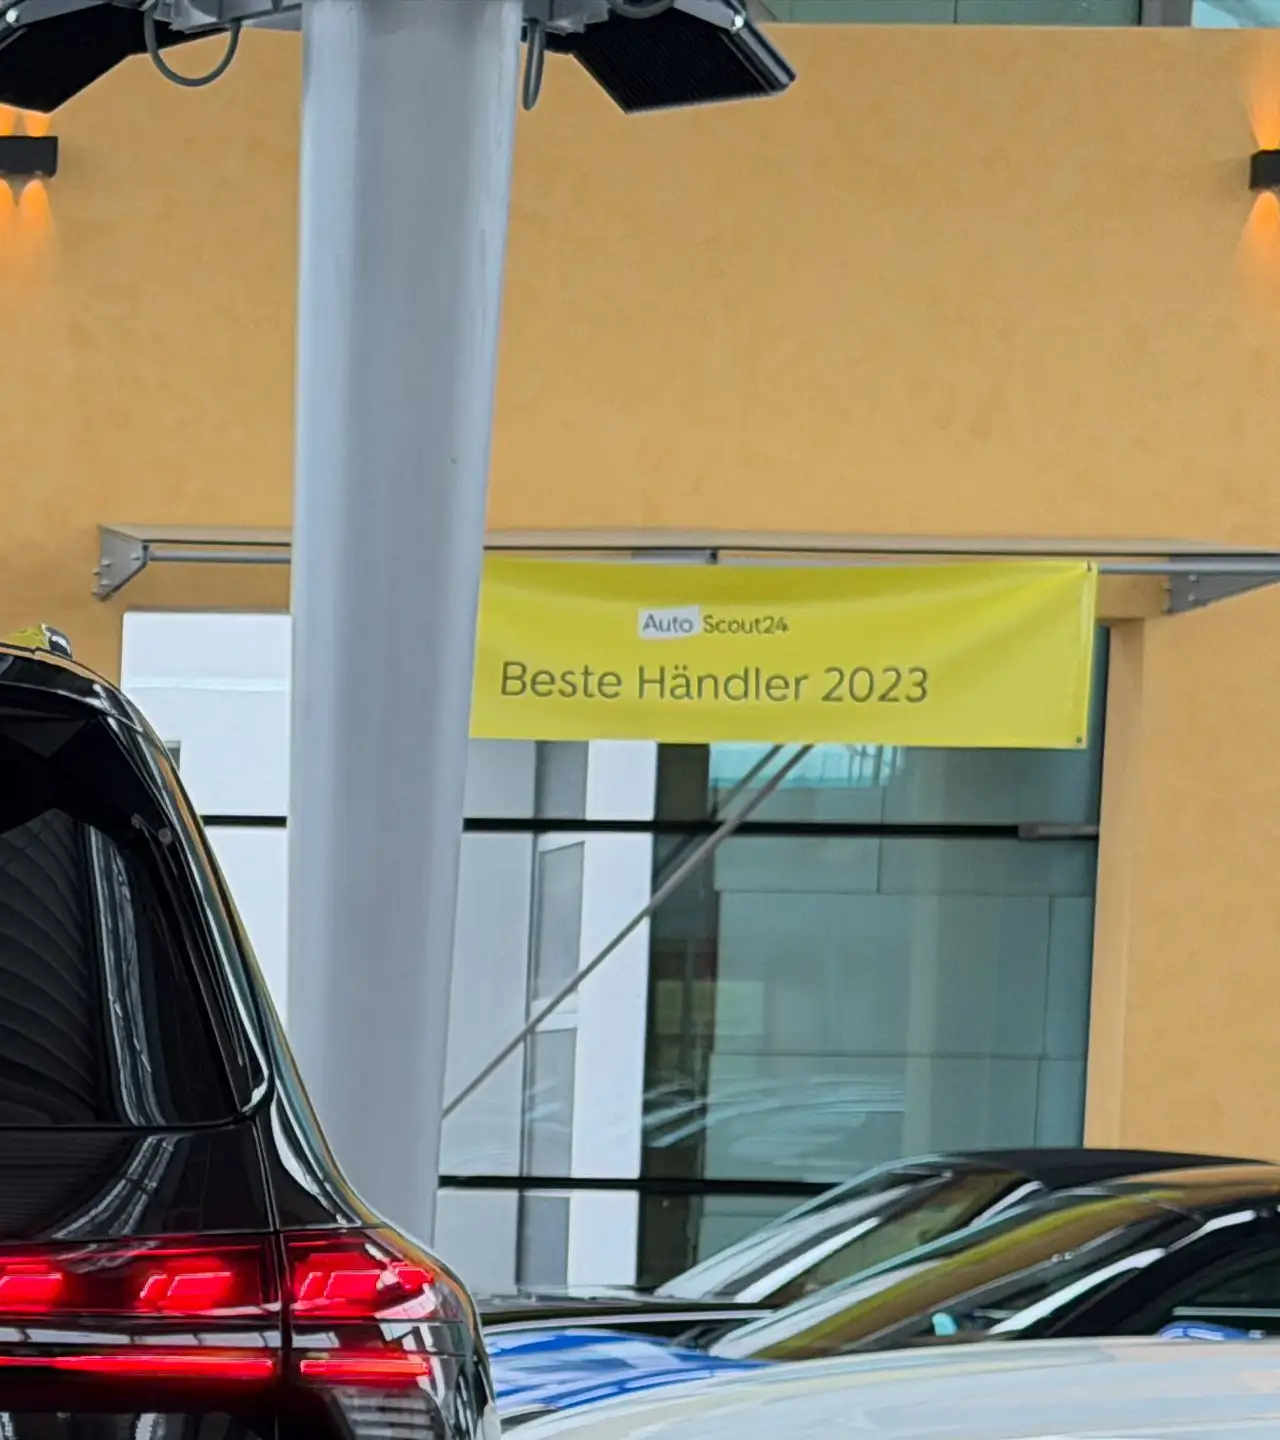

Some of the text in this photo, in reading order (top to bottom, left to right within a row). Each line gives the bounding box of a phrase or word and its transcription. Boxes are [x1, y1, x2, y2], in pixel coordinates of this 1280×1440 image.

[643, 614, 789, 635] Auto Scout24
[500, 661, 928, 703] Beste Händler 2023
